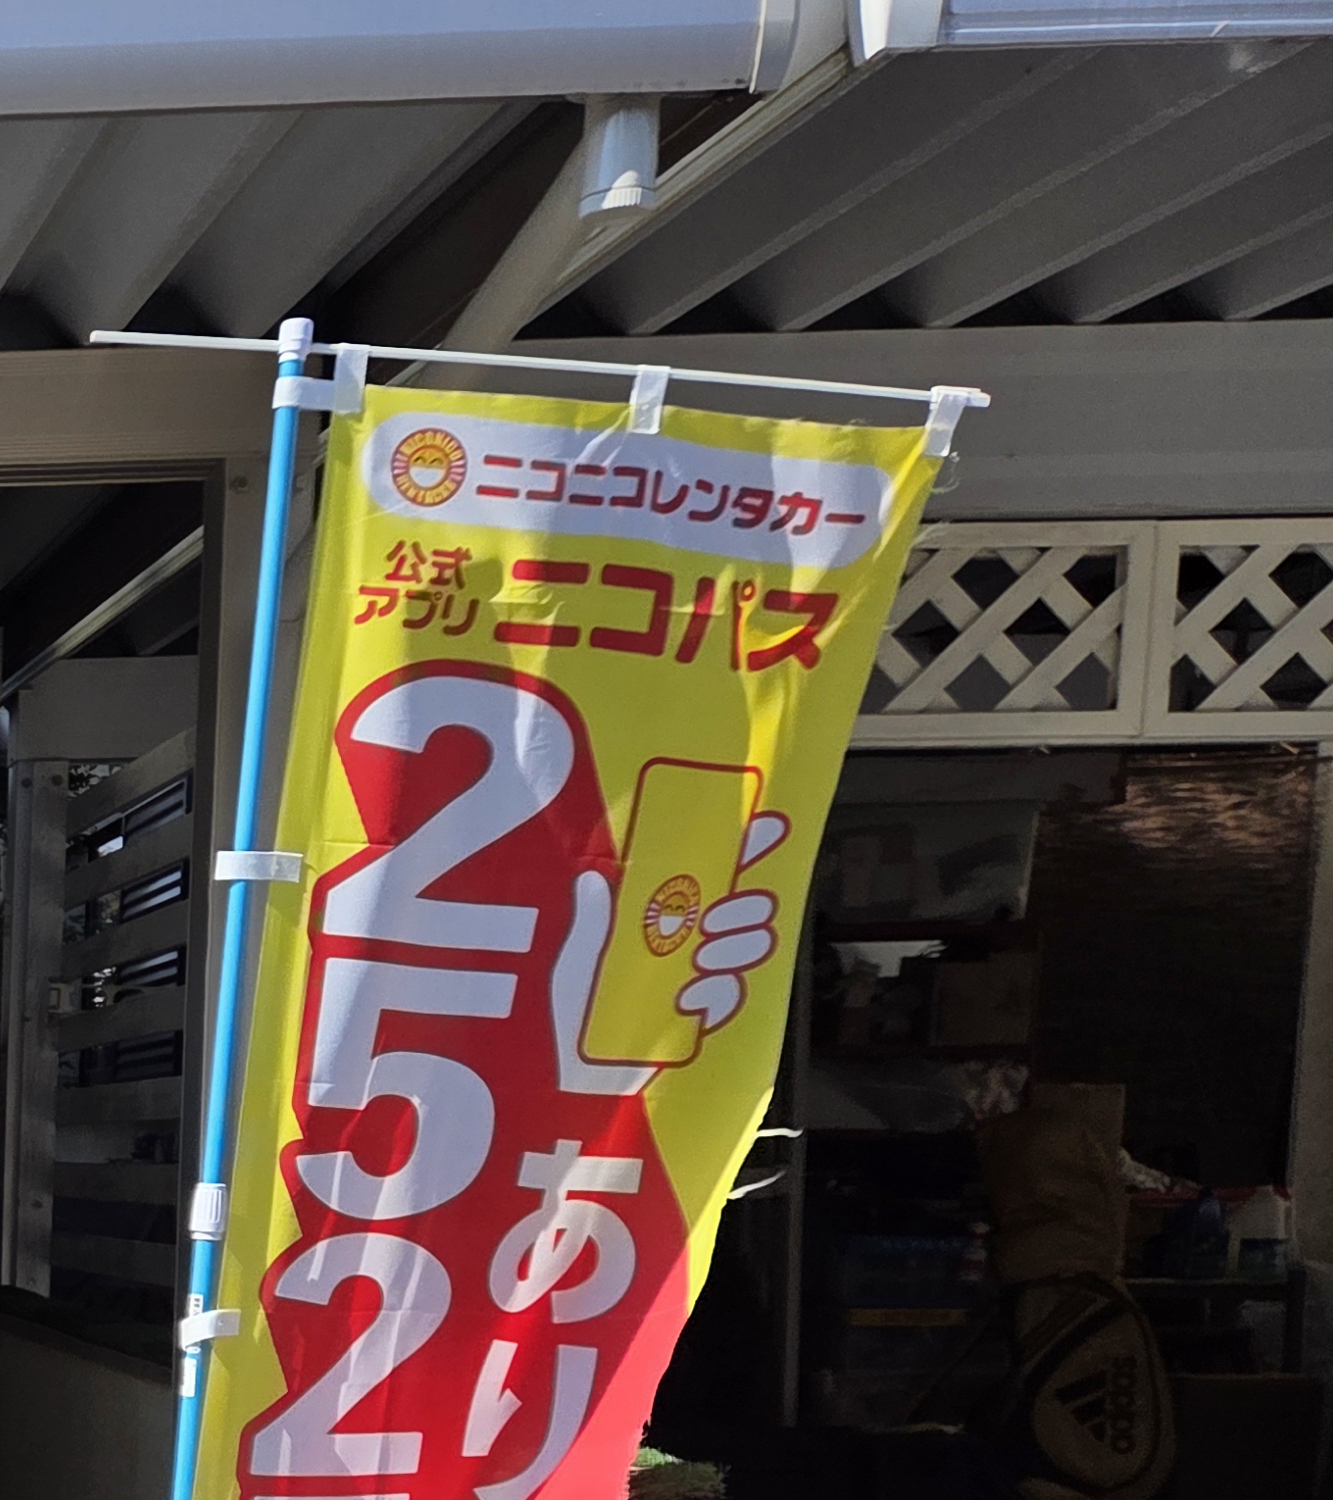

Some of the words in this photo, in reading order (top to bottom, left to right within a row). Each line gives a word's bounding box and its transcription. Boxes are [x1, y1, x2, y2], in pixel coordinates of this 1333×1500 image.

[475, 455, 865, 536] ニコニコレンタカー
[385, 540, 472, 590] 公式
[354, 585, 480, 636] アプリ
[493, 559, 839, 672] ニコパス
